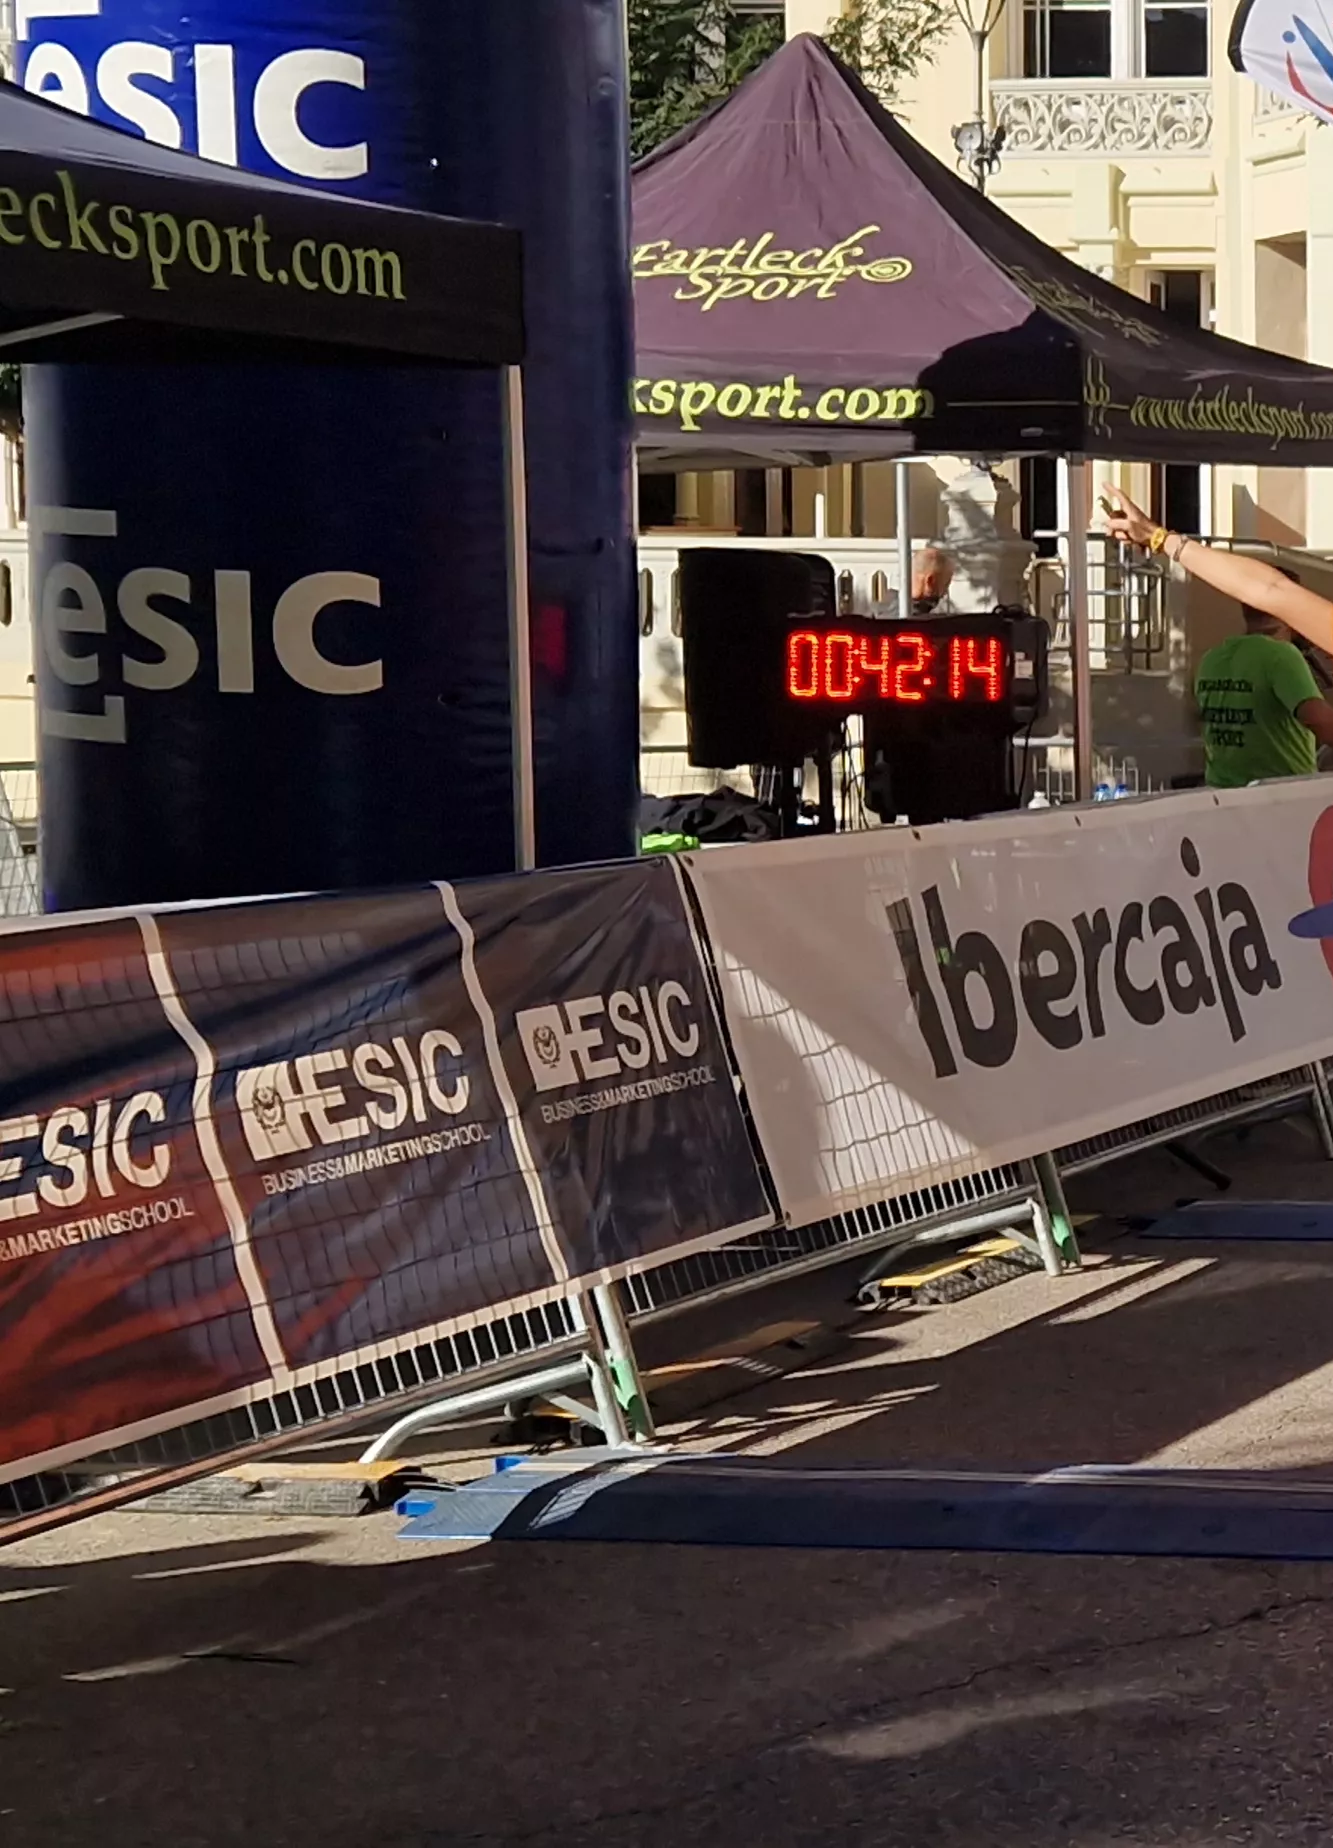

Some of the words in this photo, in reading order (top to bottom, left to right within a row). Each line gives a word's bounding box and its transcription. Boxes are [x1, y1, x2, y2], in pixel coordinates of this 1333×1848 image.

[0, 170, 407, 300] ecksport.com
[633, 225, 881, 275] Fartleck
[674, 266, 846, 312] Sport
[884, 837, 1282, 1078] Ibercaja
[566, 980, 699, 1079] ESIC
[300, 1029, 470, 1150] ESIC
